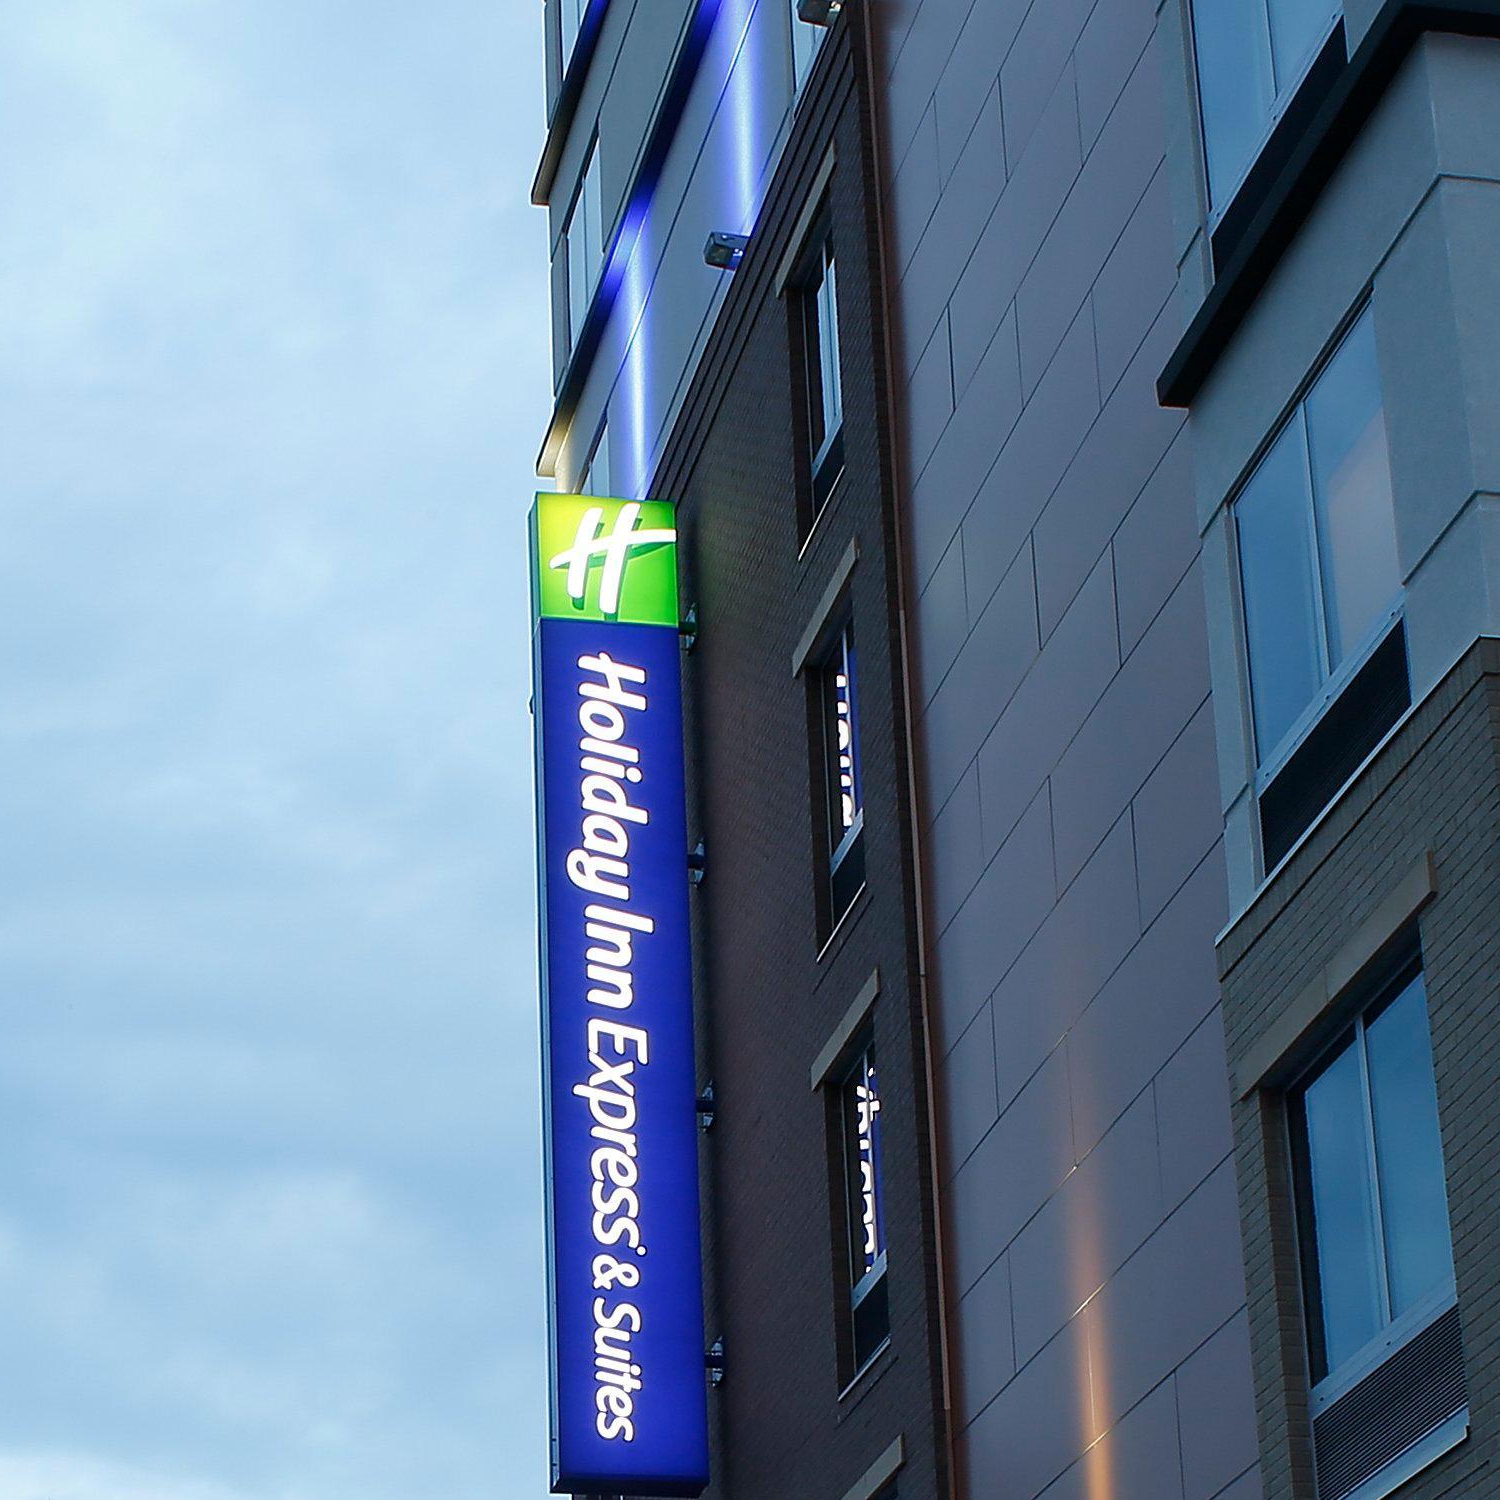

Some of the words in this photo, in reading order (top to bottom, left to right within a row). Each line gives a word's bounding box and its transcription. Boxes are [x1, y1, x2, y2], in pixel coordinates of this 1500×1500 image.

[565, 650, 647, 901] Holiday
[583, 903, 655, 1011] Inn
[571, 1017, 650, 1251] Express
[591, 1253, 641, 1290] &
[593, 1296, 643, 1443] Suites
